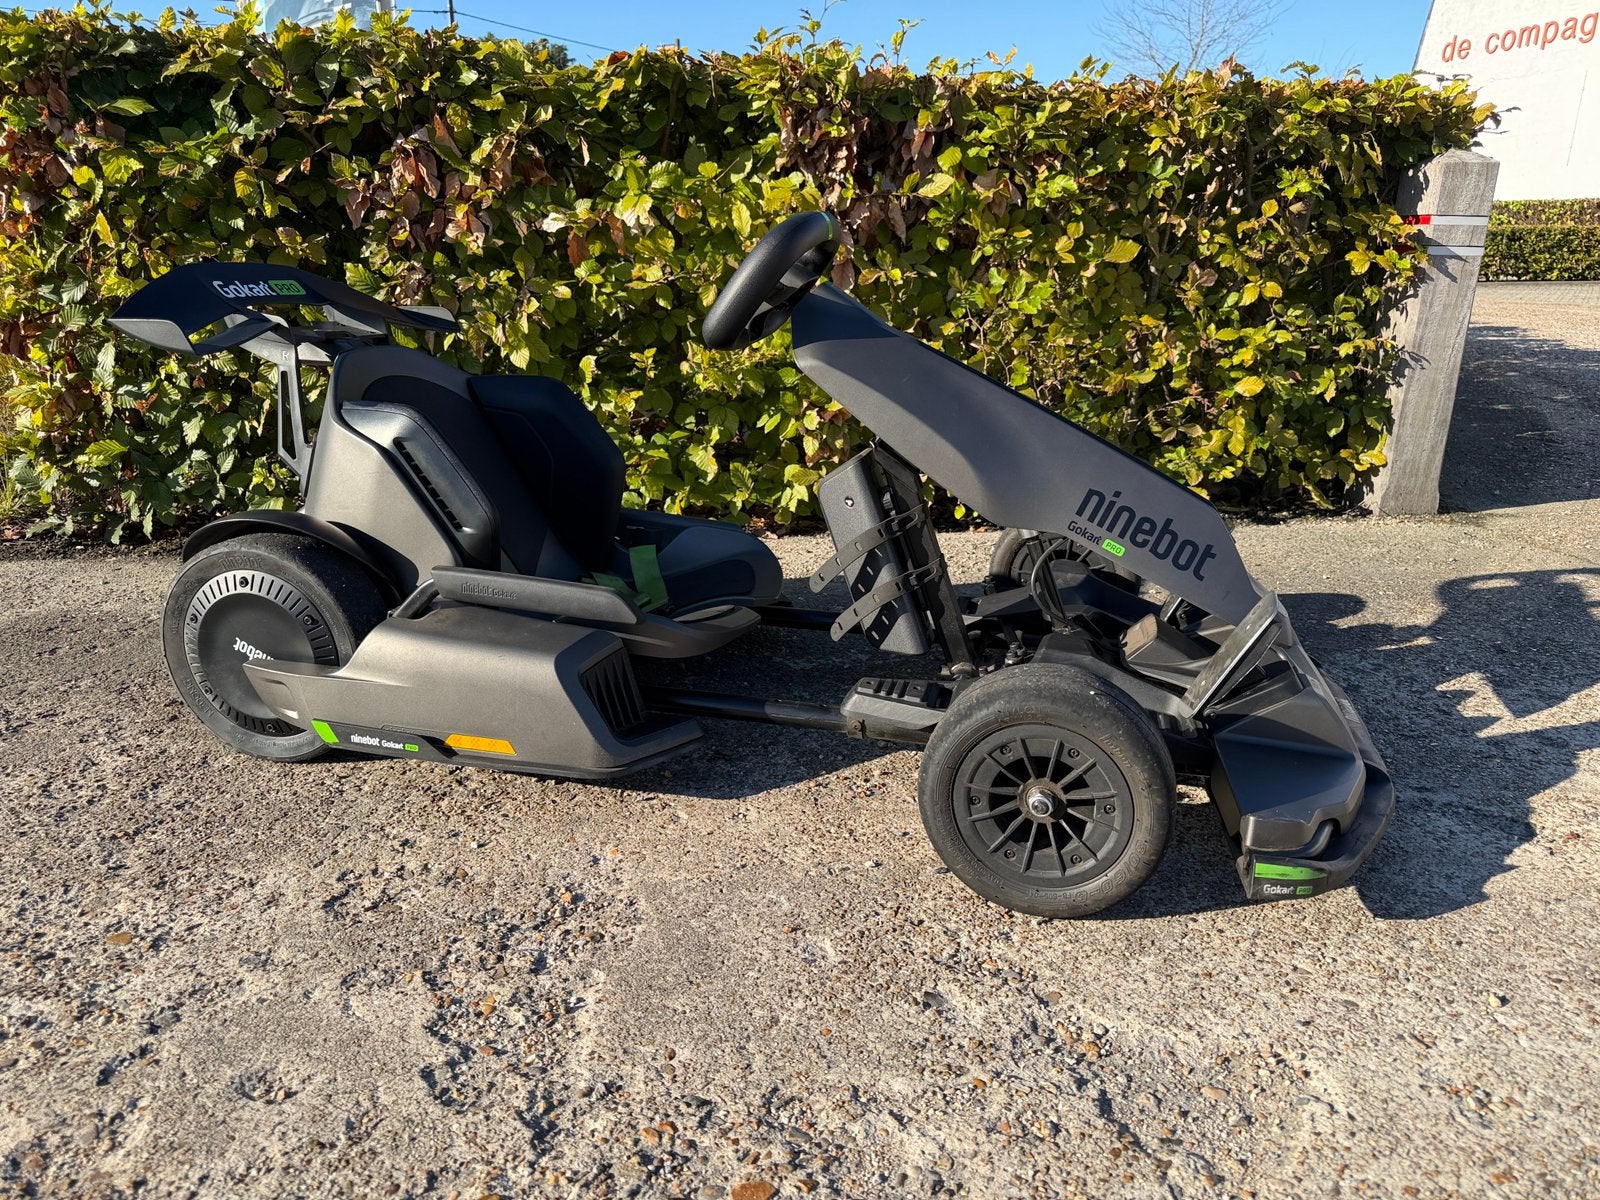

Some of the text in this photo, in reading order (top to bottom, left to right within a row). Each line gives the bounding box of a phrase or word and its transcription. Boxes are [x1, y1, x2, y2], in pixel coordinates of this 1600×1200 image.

[1441, 12, 1599, 63] de compag
[212, 280, 277, 298] Gokart
[1067, 520, 1122, 555] Gokart PRO
[1075, 488, 1217, 582] ninebot
[461, 582, 493, 597] ninebot
[350, 735, 380, 746] ninebot
[382, 740, 404, 750] Gokart
[1263, 884, 1295, 895] Gokart
